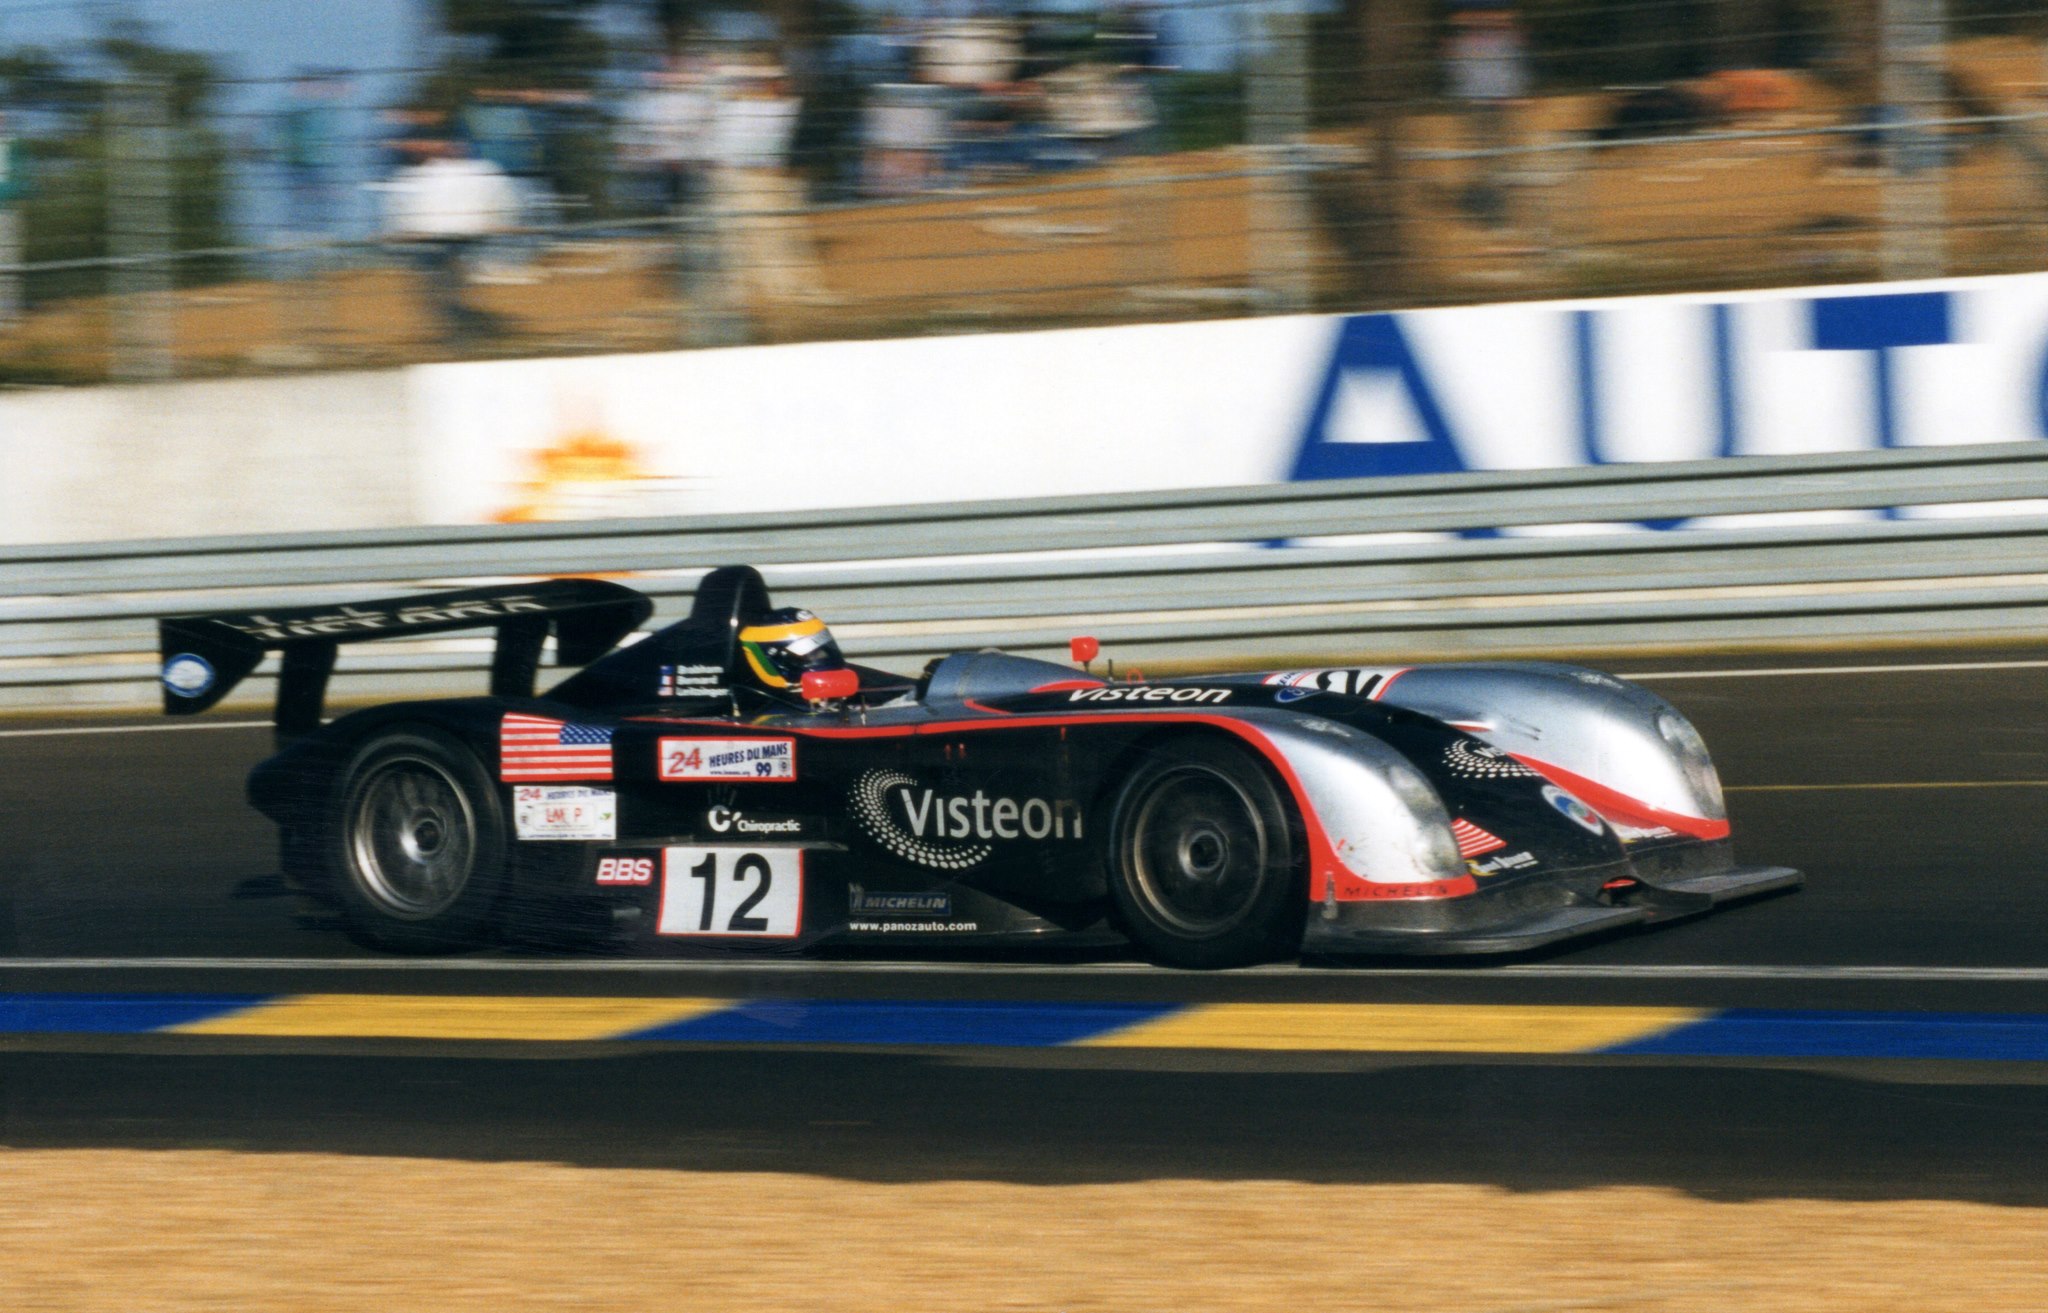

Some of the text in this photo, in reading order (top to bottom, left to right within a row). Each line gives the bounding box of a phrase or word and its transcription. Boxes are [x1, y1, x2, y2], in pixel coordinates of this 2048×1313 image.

[1266, 290, 2048, 546] AUT
[668, 747, 703, 774] 24
[708, 750, 745, 768] HEURES
[746, 748, 760, 761] DU
[762, 742, 788, 757] MANS
[755, 762, 772, 776] 99
[900, 788, 1084, 840] Visteon
[736, 818, 801, 834] Chiropractic
[596, 858, 653, 882] BBS
[690, 852, 773, 932] 12
[1343, 884, 1450, 898] MICHELIN
[864, 896, 947, 909] MICHELIN
[849, 920, 978, 933] www.panozauto.com
